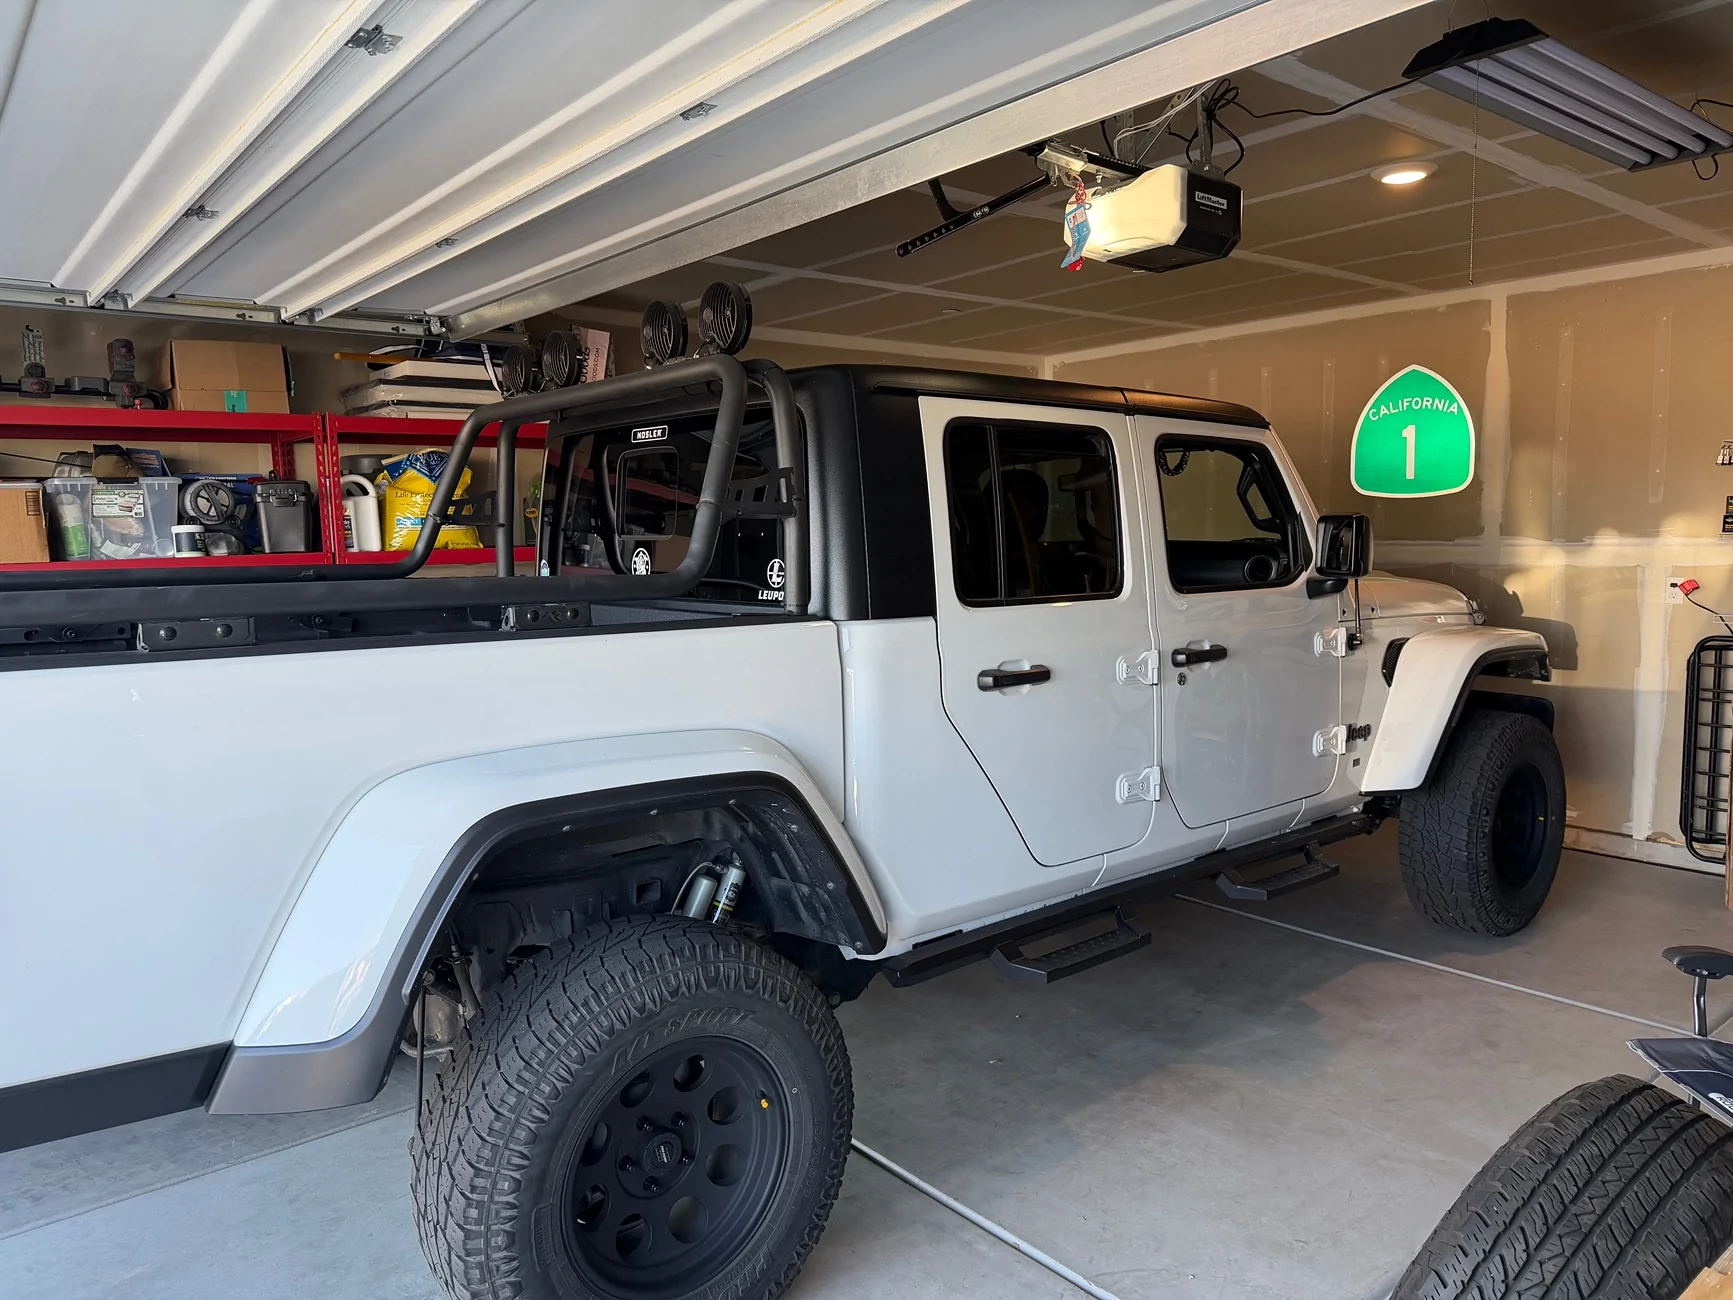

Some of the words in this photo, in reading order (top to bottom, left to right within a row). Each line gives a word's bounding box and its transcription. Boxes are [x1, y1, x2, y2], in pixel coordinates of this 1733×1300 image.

[1197, 193, 1225, 207] LiftMaster
[1369, 397, 1458, 421] CALIFORNIA
[636, 429, 663, 440] NOSLER
[1402, 424, 1416, 480] 1
[758, 590, 785, 601] LEUPO
[1346, 723, 1371, 743] Jeep
